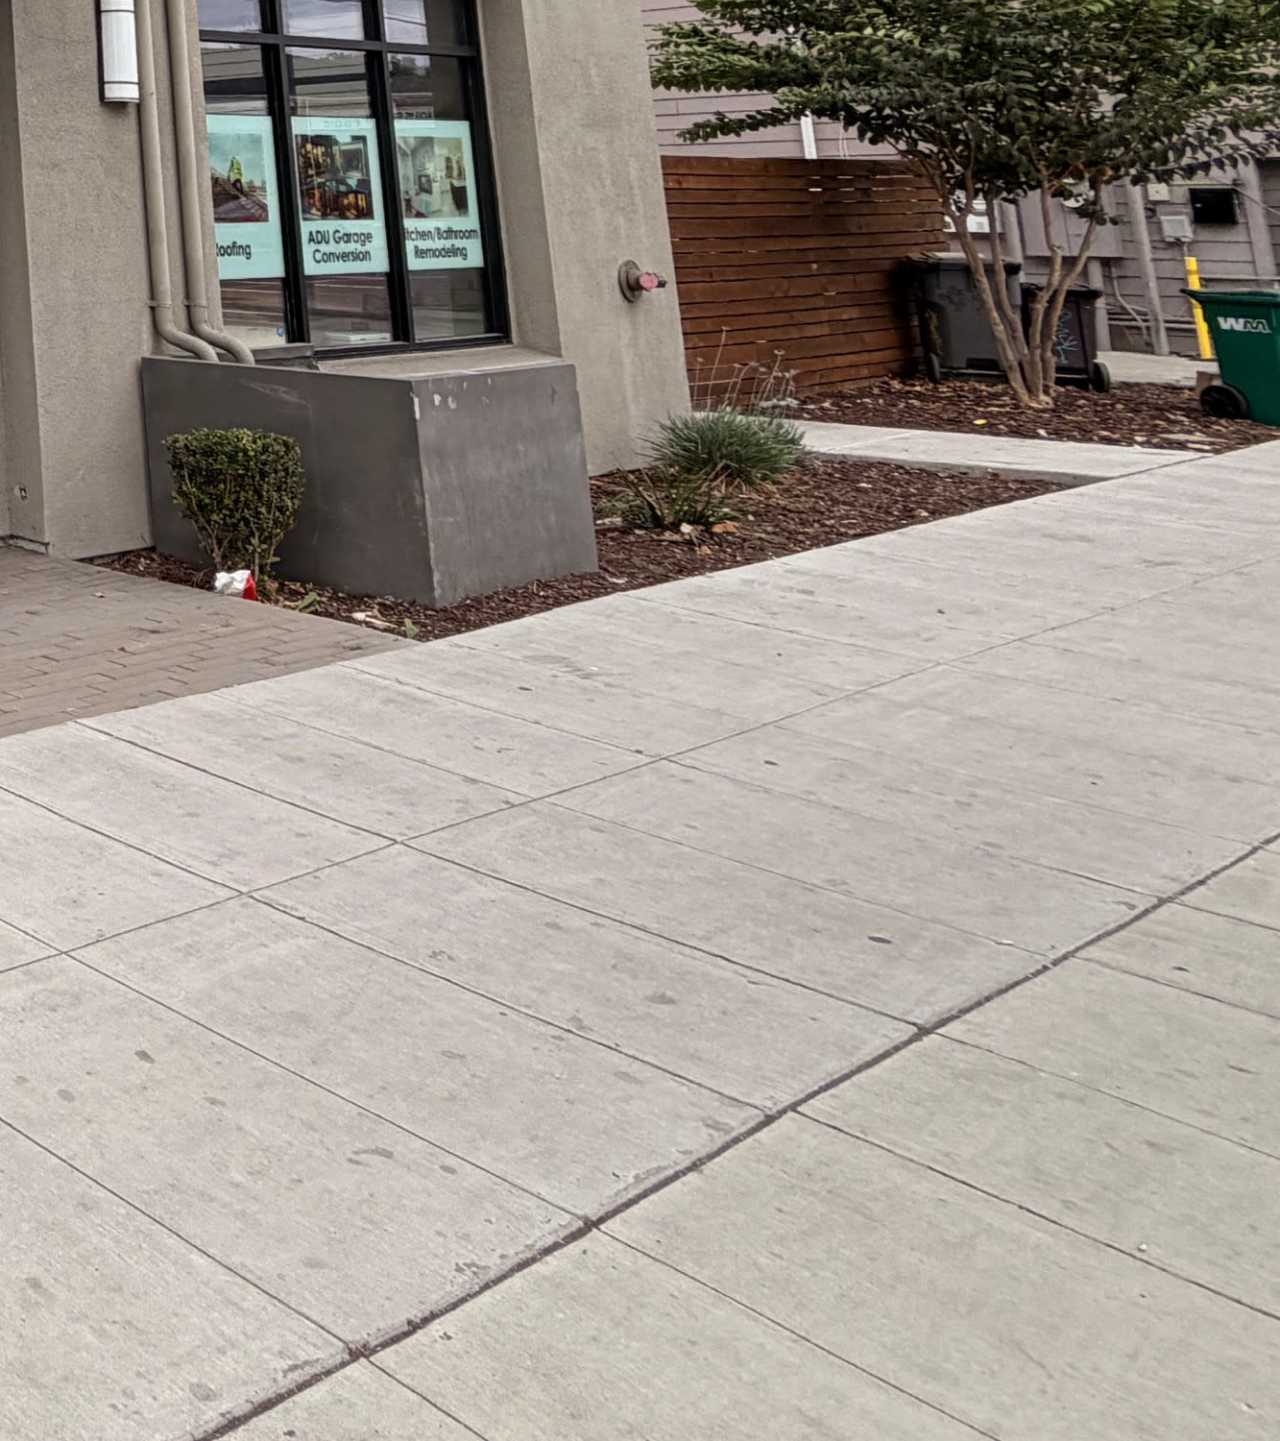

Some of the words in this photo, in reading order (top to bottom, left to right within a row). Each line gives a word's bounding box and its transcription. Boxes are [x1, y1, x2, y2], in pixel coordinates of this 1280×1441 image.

[308, 230, 330, 245] ADU
[332, 228, 373, 249] Garage
[313, 247, 372, 265] Conversion
[414, 244, 468, 261] Remodeling
[1217, 317, 1272, 333] WM
